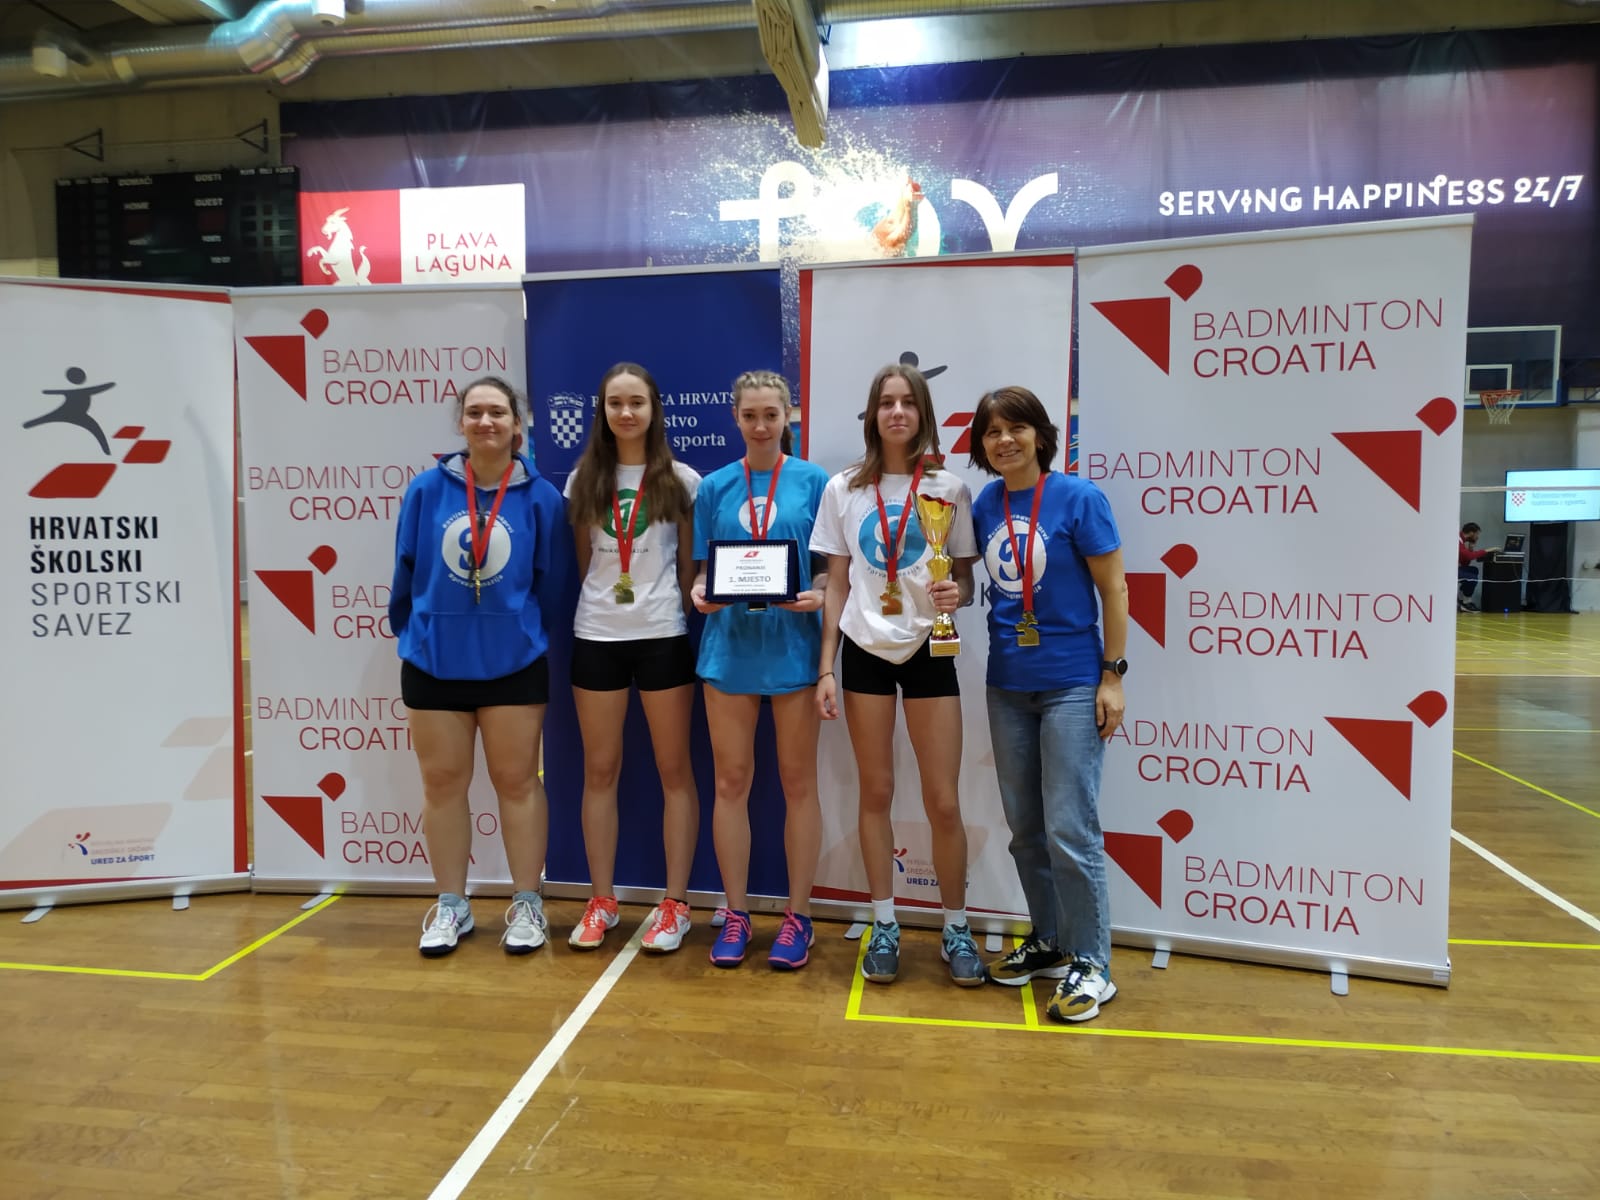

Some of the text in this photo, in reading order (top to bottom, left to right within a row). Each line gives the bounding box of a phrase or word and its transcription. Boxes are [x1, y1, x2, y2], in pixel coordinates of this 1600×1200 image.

[1159, 174, 1584, 216] SERVING HAPPINESS 24/7
[427, 232, 499, 250] PLAVA
[415, 253, 512, 277] LAGUNA
[1192, 297, 1443, 341] BADMINTON
[323, 346, 507, 374] BADMINTON
[1193, 340, 1376, 379] CROATIA
[325, 378, 461, 406] CROATIA
[673, 433, 726, 452] sporta
[1088, 447, 1321, 480] BADMINTON
[289, 495, 404, 521] CROAT
[1141, 484, 1318, 516] CROATIA
[30, 516, 159, 540] HRVATSKI
[30, 545, 142, 574] ŠKOLSKI
[31, 580, 181, 607] SPORTSKI
[1188, 590, 1433, 623] BADMINTON
[32, 612, 132, 638] SAVEZ
[1188, 625, 1368, 660] CROATIA
[257, 696, 408, 721] BADMINTO
[299, 726, 414, 751] CROATI
[1107, 720, 1314, 757] ADMINTON
[1138, 754, 1311, 793] CROATIA
[906, 877, 929, 886] URED
[1185, 856, 1424, 906] BADMINTON
[1184, 889, 1360, 936] CROATIA
